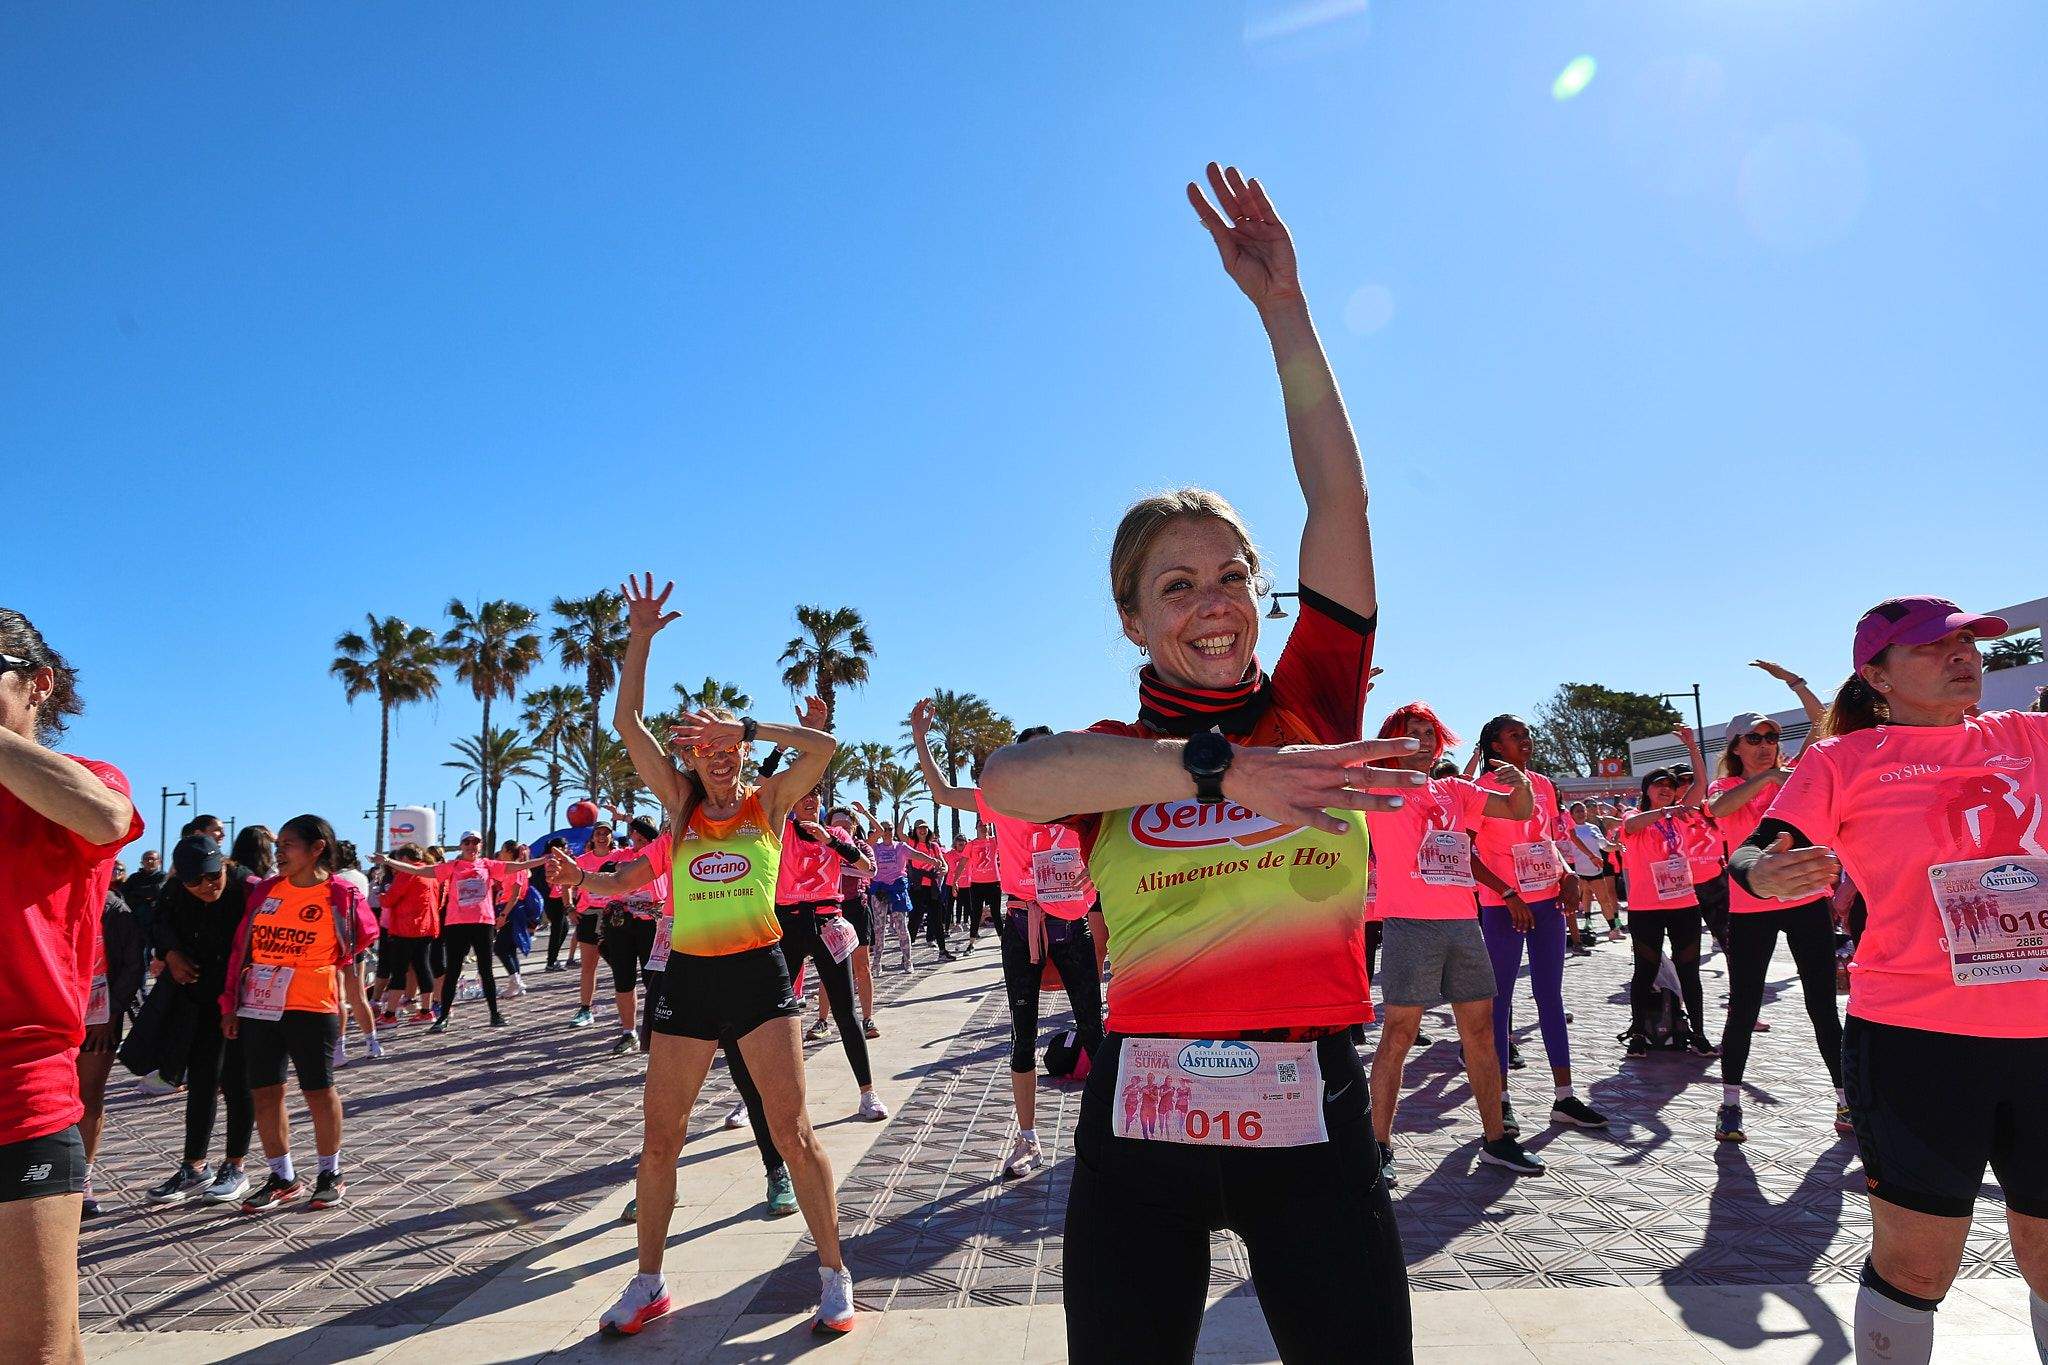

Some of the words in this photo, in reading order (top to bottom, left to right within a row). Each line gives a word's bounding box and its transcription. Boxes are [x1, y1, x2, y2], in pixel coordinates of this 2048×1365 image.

[1879, 764, 1941, 782] OYSHO
[1439, 854, 1459, 864] 016
[694, 861, 746, 875] Serrano
[1135, 859, 1250, 894] Alimentos
[1257, 851, 1286, 869] de
[1292, 847, 1341, 869] Hoy
[1533, 862, 1551, 871] 016
[1055, 871, 1076, 881] 016
[689, 892, 706, 901] COME
[709, 890, 725, 899] BIEN
[727, 889, 732, 898] Y
[733, 888, 754, 897] CORRE
[1946, 884, 1976, 893] SUMA
[1999, 910, 2048, 933] 016
[2016, 937, 2043, 947] 2886
[1972, 952, 2005, 961] CARRERA
[2007, 951, 2016, 959] DE
[2017, 950, 2026, 958] LA
[2028, 948, 2048, 957] MUJE
[1972, 964, 2021, 977] OYSHO
[255, 988, 271, 998] 016
[1135, 1057, 1169, 1068] SUMA
[1182, 1051, 1254, 1068] ASTURIANA
[1185, 1109, 1263, 1141] 016
